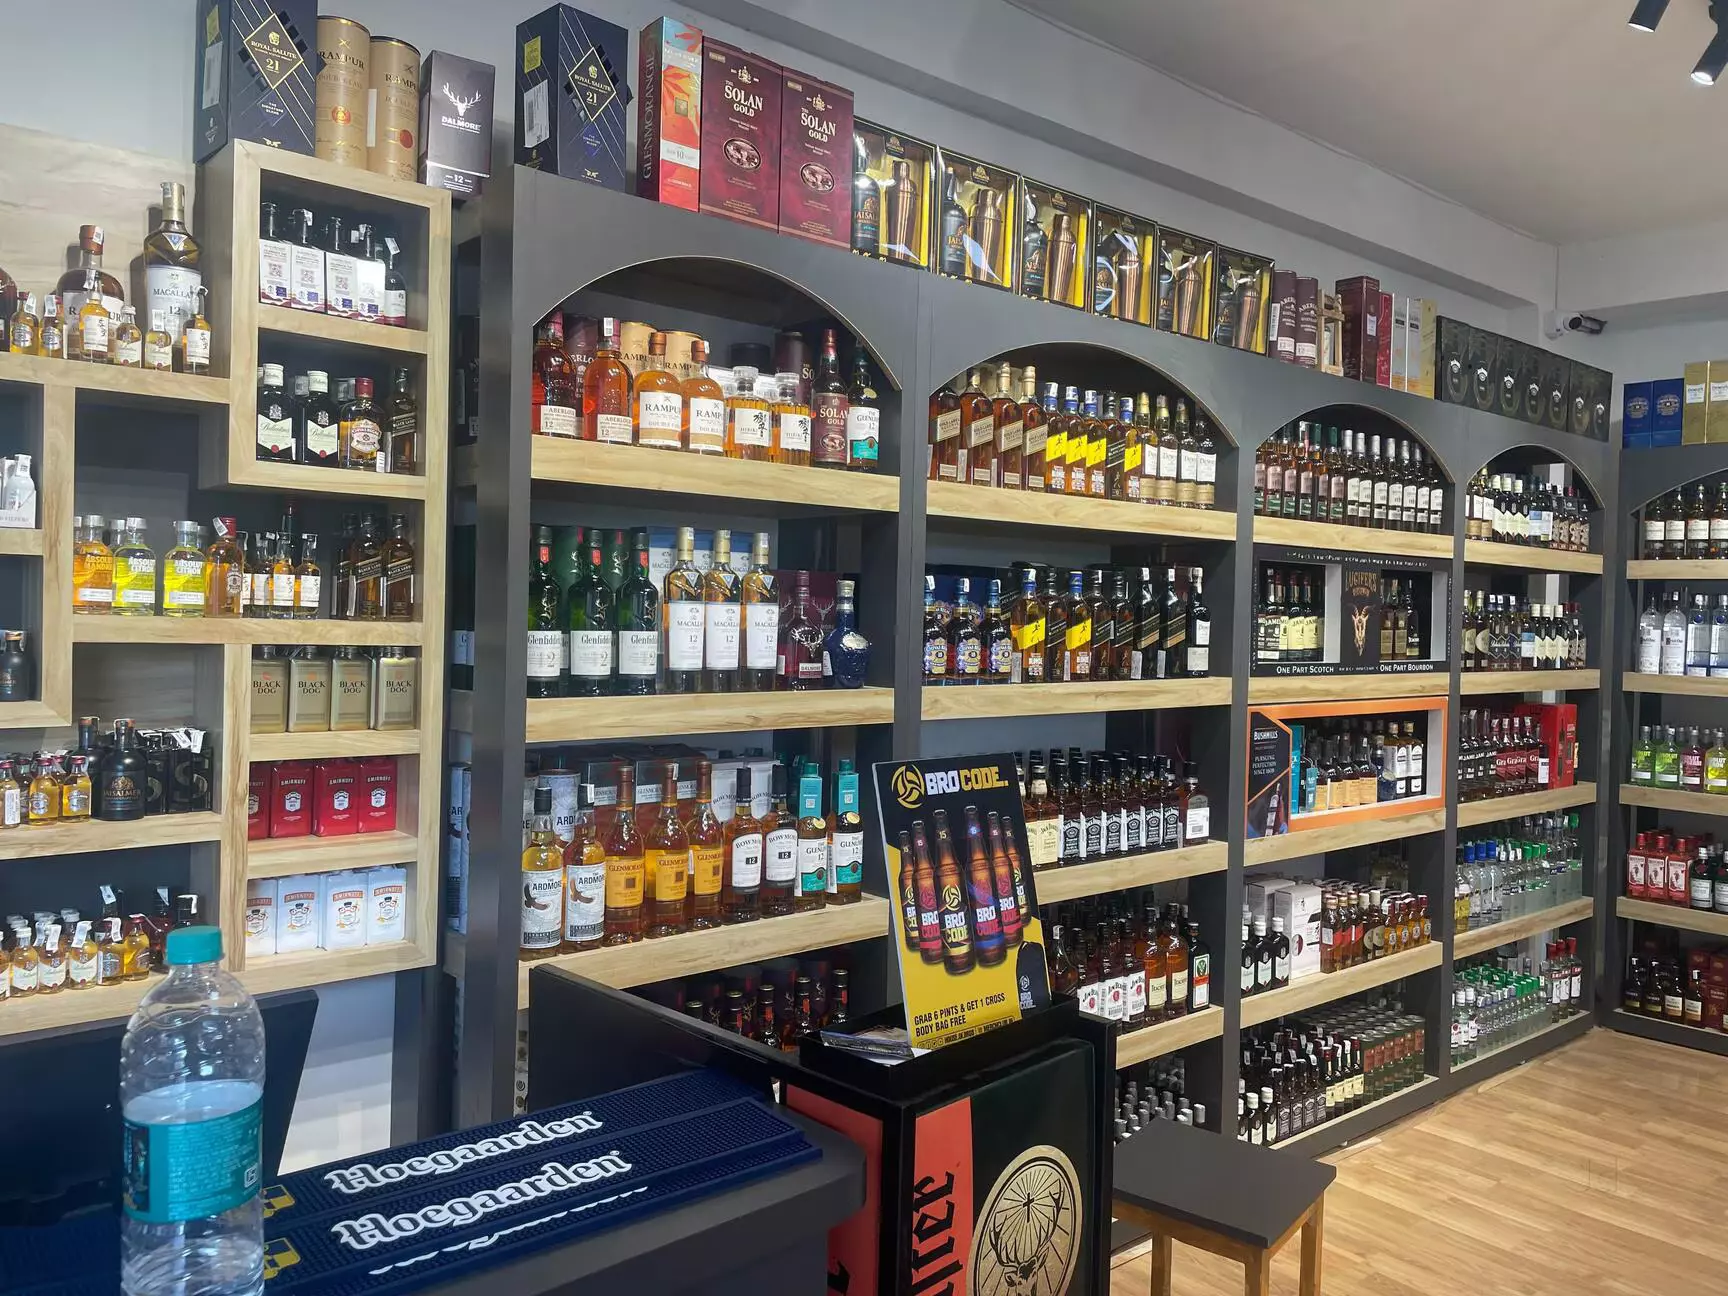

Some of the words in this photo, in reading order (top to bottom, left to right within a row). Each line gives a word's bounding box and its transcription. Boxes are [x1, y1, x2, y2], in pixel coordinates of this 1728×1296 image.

[251, 40, 272, 52] ROYAL
[272, 47, 297, 59] SALUTE
[265, 58, 280, 71] 21
[319, 51, 364, 69] RAMPUR
[591, 78, 612, 92] SALUTE
[586, 91, 597, 104] 21
[724, 85, 763, 111] SOLAN
[733, 102, 755, 117] GOLD
[441, 116, 481, 131] DALMORE
[801, 112, 836, 136] SOLAN
[808, 129, 828, 142] GOLD
[454, 174, 463, 183] 12
[169, 305, 181, 315] 12
[827, 418, 845, 426] GOLD
[689, 634, 698, 643] 12
[726, 635, 734, 643] 12
[766, 635, 774, 643] 12
[1276, 666, 1291, 674] ONE
[1292, 666, 1308, 674] PART
[1309, 665, 1334, 674] SCOTCH
[1379, 663, 1392, 672] ONE
[1393, 663, 1407, 671] PART
[1407, 663, 1434, 672] BOURBON
[252, 680, 281, 688] BLACK
[298, 680, 326, 688] BLACK
[339, 680, 366, 688] BLACK
[343, 686, 361, 694] DOG
[386, 680, 412, 688] BLACK
[1254, 730, 1278, 741] BUSHMILLS
[921, 910, 939, 926] BRO
[944, 911, 965, 929] BRO
[975, 905, 996, 923] BRO
[921, 924, 941, 939] COD
[914, 1012, 933, 1026] GRAB
[933, 1010, 939, 1021] 6
[939, 1005, 959, 1019] PINTS
[960, 1004, 965, 1013] &
[966, 999, 979, 1010] GET
[979, 998, 984, 1008] 1
[985, 992, 1006, 1006] CROSS
[915, 1024, 933, 1037] BODY
[935, 1020, 949, 1031] BAG
[950, 1014, 967, 1028] FREE
[324, 1111, 603, 1195] Hoegaarden
[330, 1150, 633, 1251] Hoegaarden
